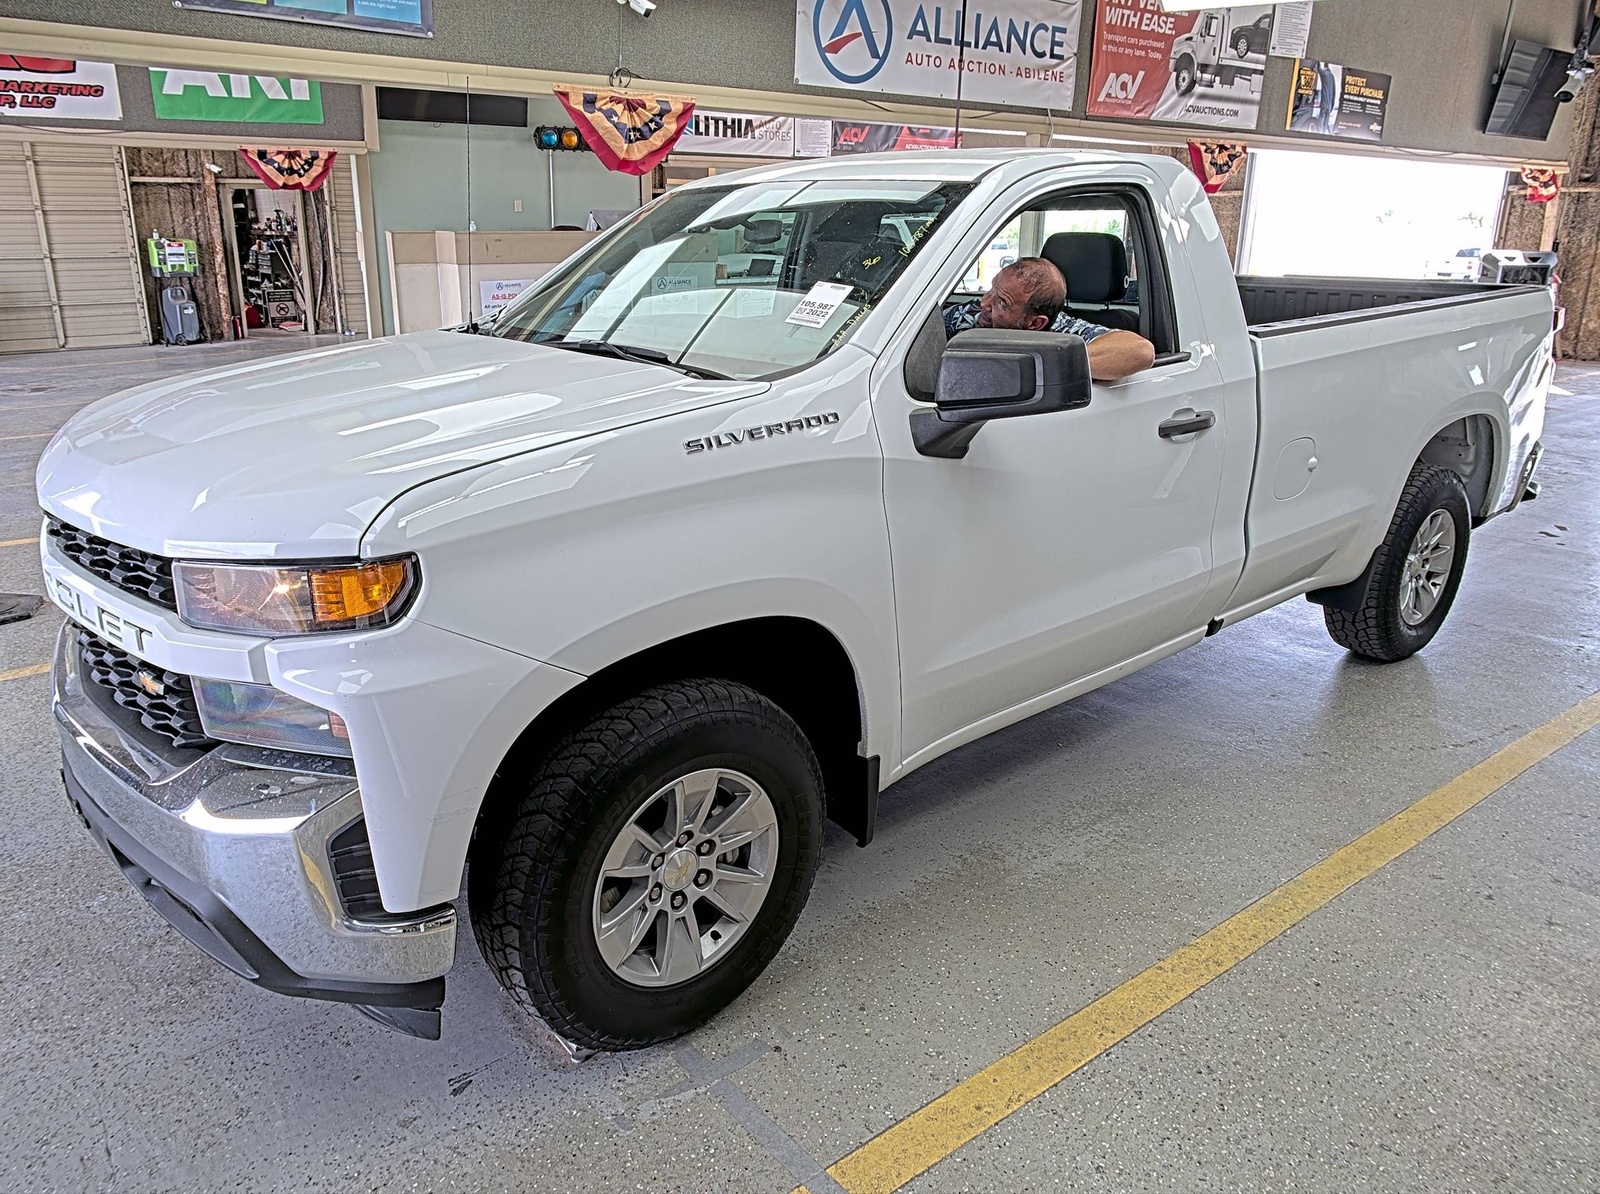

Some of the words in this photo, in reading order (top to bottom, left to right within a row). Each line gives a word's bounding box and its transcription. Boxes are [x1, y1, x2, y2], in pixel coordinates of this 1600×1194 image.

[1105, 6, 1140, 29] WITH
[1141, 13, 1176, 35] EASE.
[906, 3, 1068, 61] ALLIANCE
[1103, 32, 1127, 43] Transport
[1127, 36, 1138, 44] cars
[1139, 38, 1165, 49] purchased
[1102, 43, 1107, 51] in
[1107, 44, 1118, 53] this
[1124, 47, 1134, 57] any
[1134, 49, 1147, 57] lane.
[1147, 49, 1163, 60] Today.
[905, 52, 943, 69] AUTO
[948, 58, 1006, 76] AUCTION
[1015, 66, 1065, 83] ABILENE
[1097, 70, 1146, 102] ACV
[1344, 84, 1360, 95] EVERY
[20, 95, 56, 109] LLC
[694, 114, 756, 139] LITHIA
[759, 119, 782, 131] AUTO
[758, 130, 792, 142] STORES
[838, 125, 871, 144] ACV
[805, 308, 829, 318] 2022
[682, 411, 840, 456] SILVERADO
